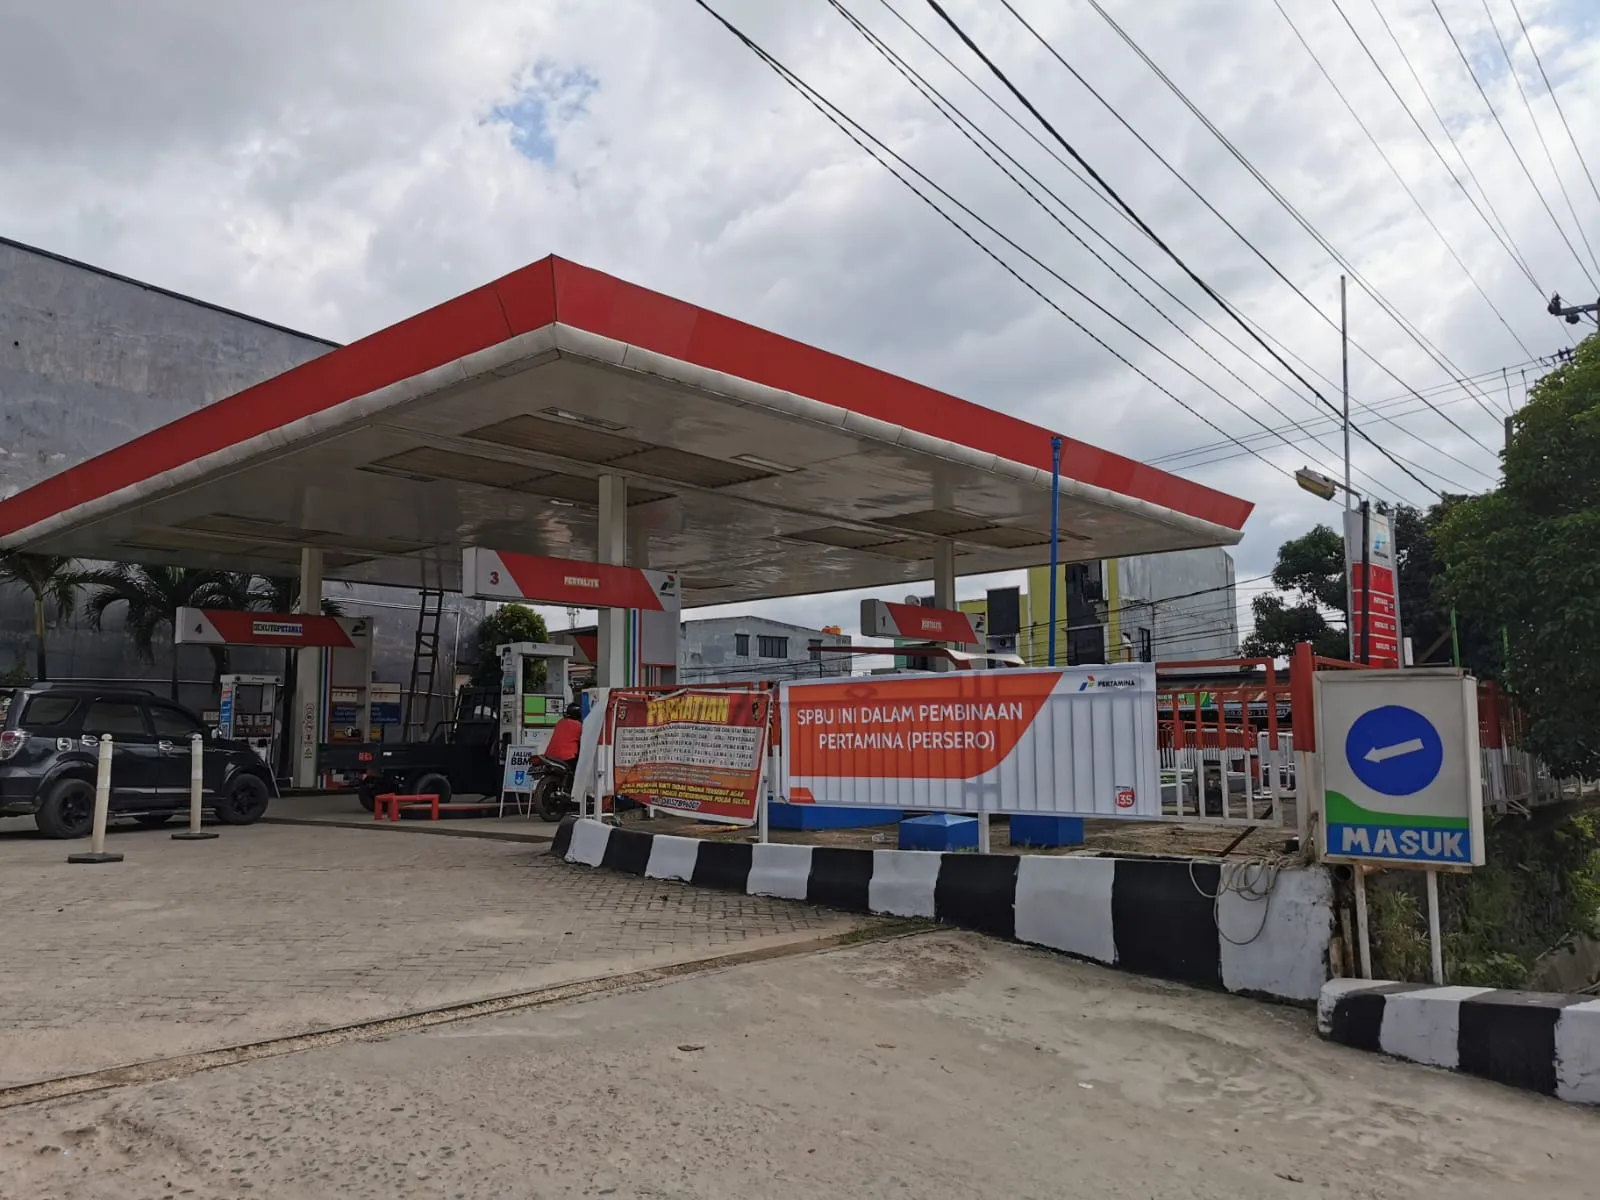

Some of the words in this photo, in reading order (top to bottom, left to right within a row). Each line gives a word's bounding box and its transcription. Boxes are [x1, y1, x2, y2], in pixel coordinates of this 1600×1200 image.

[490, 571, 499, 585] 3
[881, 616, 886, 627] 1
[195, 624, 202, 634] 4
[1098, 679, 1135, 687] PERTAMINA
[797, 709, 834, 726] SPBU
[838, 708, 857, 723] INI
[861, 705, 915, 724] DALAM
[919, 702, 1023, 722] PEMBINAAN
[819, 731, 903, 750] PERTAMINA
[907, 730, 995, 751] (PERSERO)
[1342, 827, 1464, 858] MASUK
